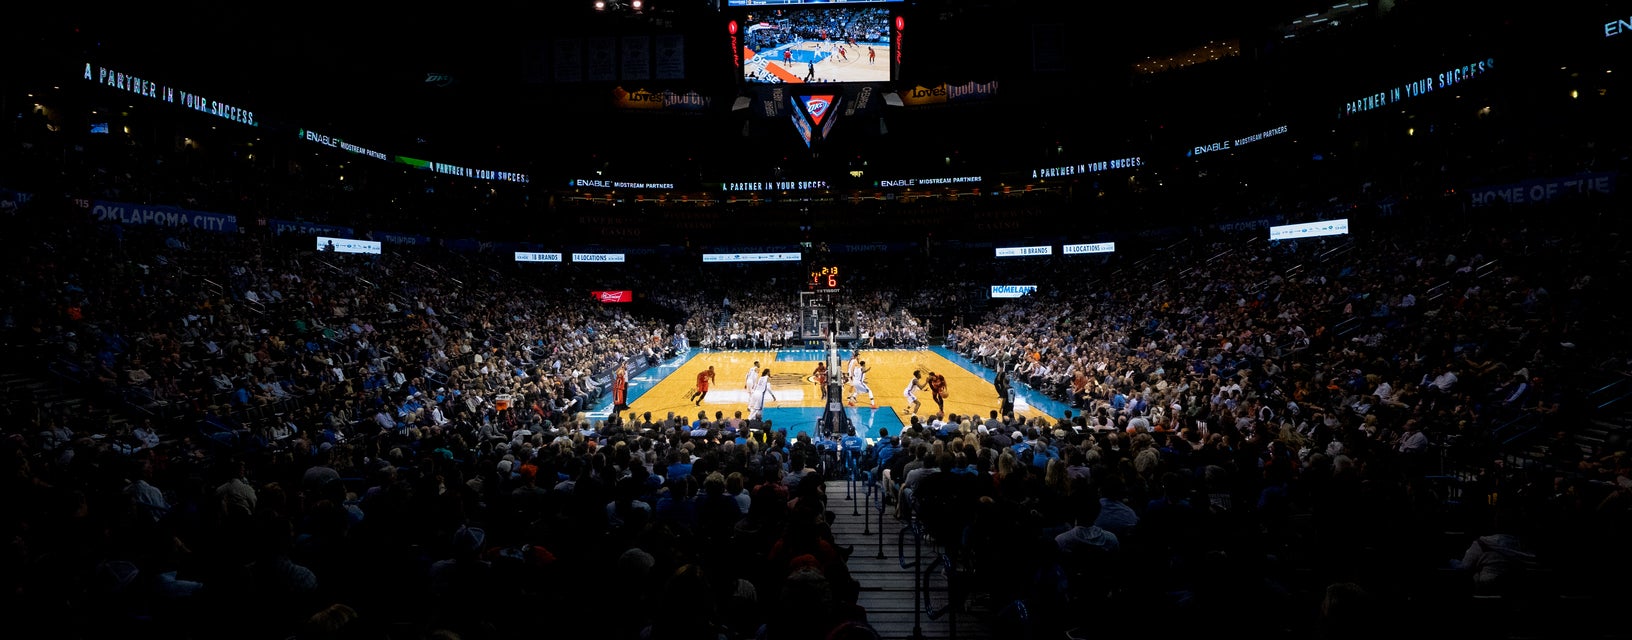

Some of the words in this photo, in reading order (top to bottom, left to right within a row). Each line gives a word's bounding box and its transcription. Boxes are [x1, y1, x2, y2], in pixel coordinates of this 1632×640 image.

[84, 62, 92, 81] A
[100, 67, 157, 98] PARTNER
[163, 86, 174, 103] IN
[180, 91, 207, 113] YOUR
[1346, 93, 1386, 116] PARTNER
[1390, 87, 1401, 103] IN
[1405, 77, 1434, 98] YOUR
[306, 131, 338, 148] ENABLE
[340, 141, 366, 155] MIDSTREAM
[366, 148, 387, 161] PARTNERS
[1194, 141, 1230, 155] ENABLE
[1234, 133, 1262, 147] MIDSTREAM
[1262, 125, 1288, 139] PARTNERS
[429, 161, 435, 171] A
[436, 163, 464, 176] PARTNER
[466, 167, 473, 178] IN
[476, 170, 496, 180] YOUR
[1032, 170, 1038, 179] A
[1040, 166, 1075, 178] PARTNER
[1077, 164, 1086, 174] IN
[1088, 161, 1108, 172] YOUR
[576, 179, 611, 188] ENABLE
[614, 181, 644, 189] MIDSTREAM
[723, 182, 728, 191] A
[730, 182, 763, 191] PARTNER
[765, 182, 773, 190] IN
[776, 181, 796, 190] YOUR
[881, 179, 915, 187] ENABLE
[1529, 183, 1560, 201] OF
[93, 205, 189, 228] OKLAHOMA
[193, 215, 225, 232] CITY
[1028, 247, 1048, 255] BRANDS
[1073, 244, 1101, 253] LOCATIONS
[822, 266, 838, 275] 2:13
[828, 274, 837, 287] 6
